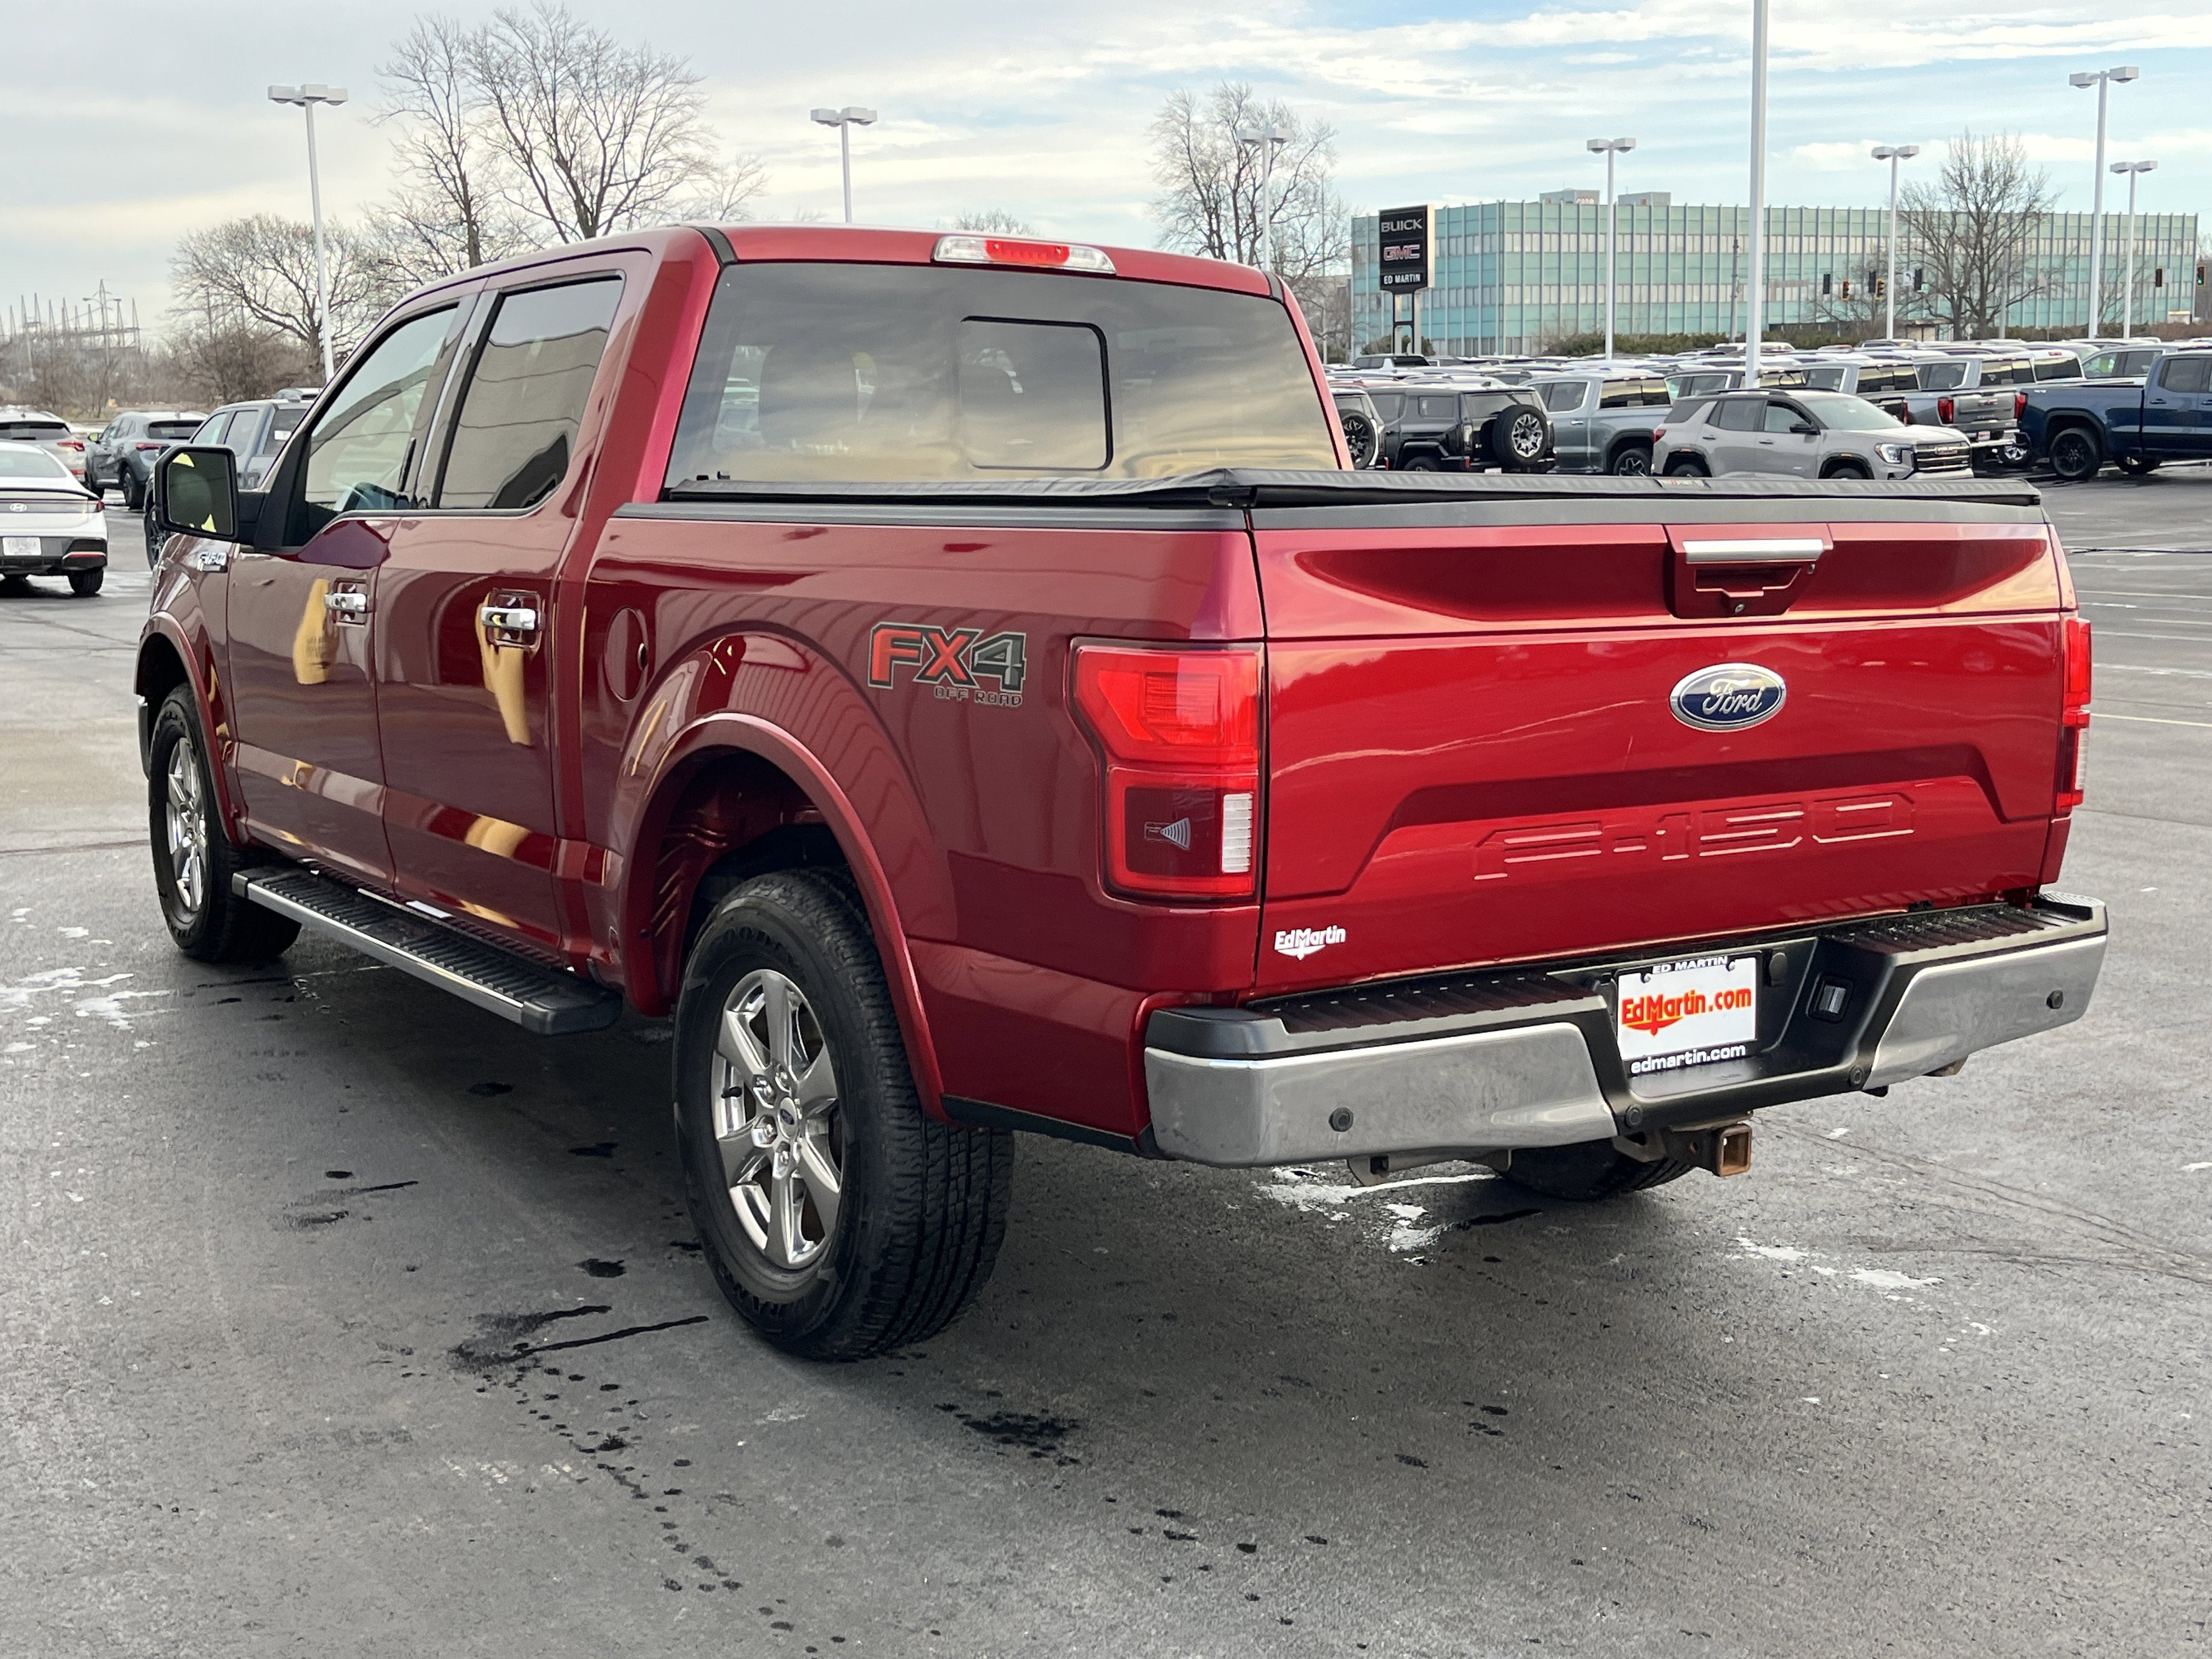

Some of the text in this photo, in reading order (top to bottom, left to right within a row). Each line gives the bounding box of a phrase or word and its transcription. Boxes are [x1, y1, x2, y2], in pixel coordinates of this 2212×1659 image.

[1381, 218, 1423, 233] BUICK
[1384, 244, 1420, 261] GMC
[1384, 274, 1420, 284] ED MARTIN
[868, 622, 1026, 693] FX4
[934, 686, 1023, 708] OFF ROAD
[1702, 679, 1766, 715] Ford
[1474, 792, 1915, 880] F-150
[1652, 956, 1728, 974] ED MARTIN
[1631, 1044, 1746, 1074] edmartin.com
